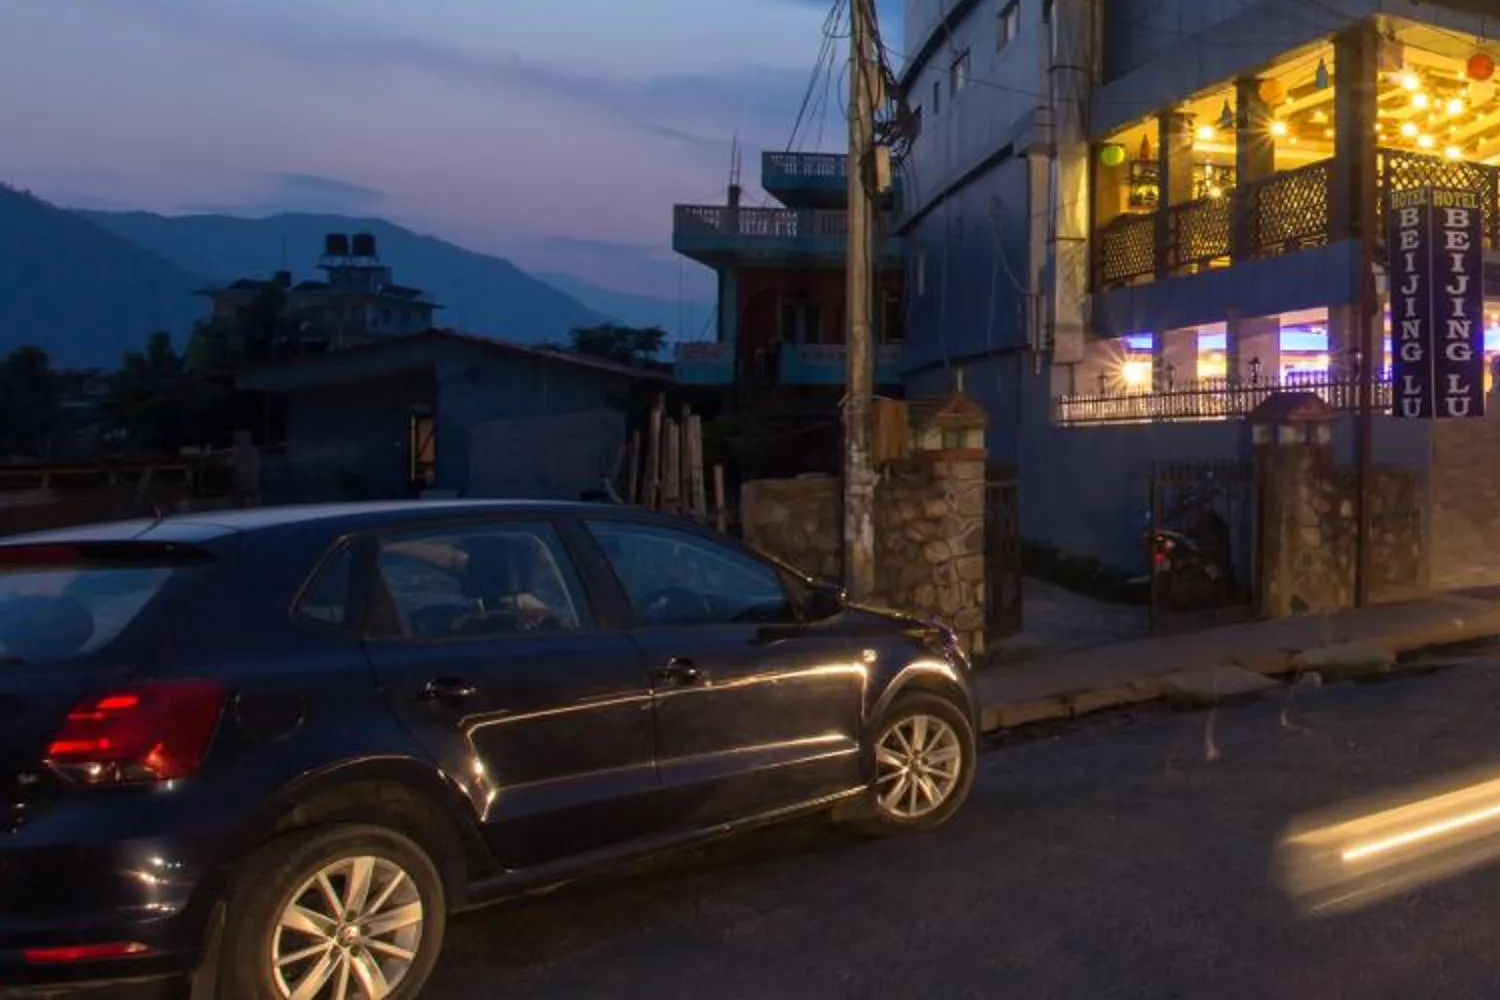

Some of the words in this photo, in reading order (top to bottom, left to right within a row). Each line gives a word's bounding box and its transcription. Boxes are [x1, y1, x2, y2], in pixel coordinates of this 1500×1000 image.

[1391, 187, 1427, 209] HOTEL
[1433, 190, 1478, 209] HOTEL
[1400, 207, 1423, 361] BEIJING
[1444, 207, 1473, 361] BEIJING
[1403, 375, 1422, 417] LU
[1446, 374, 1471, 417] LU
